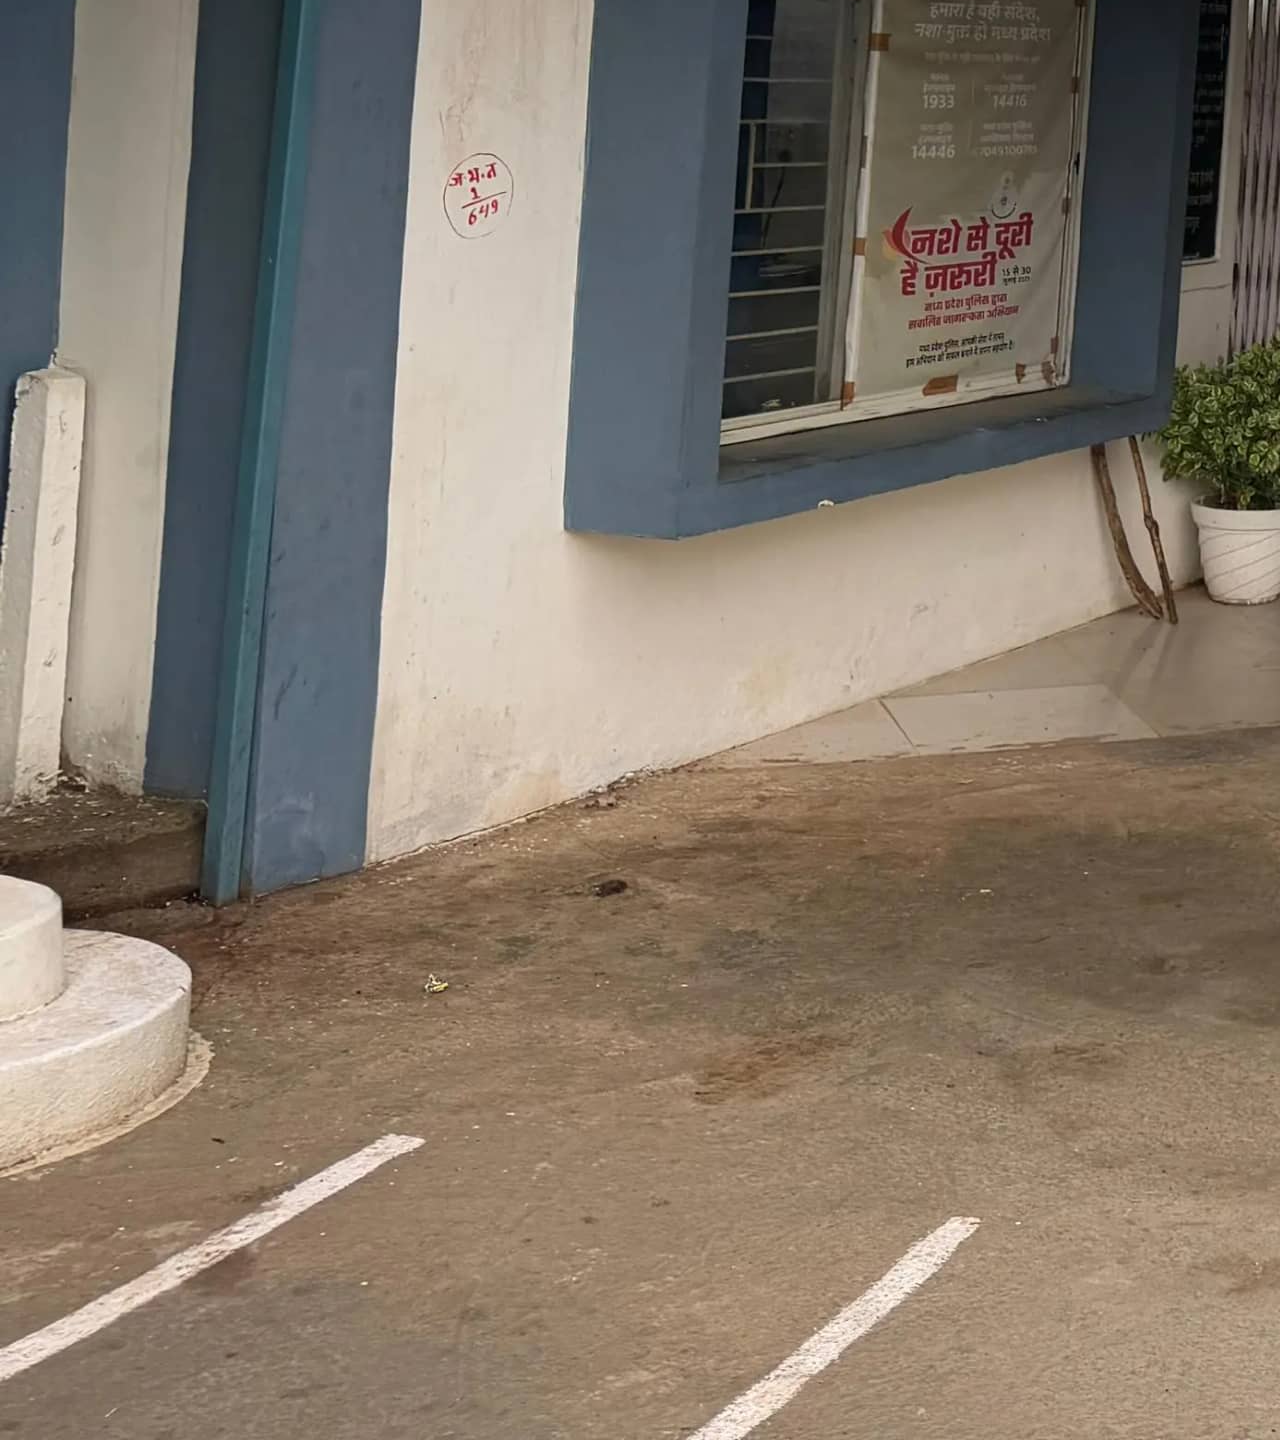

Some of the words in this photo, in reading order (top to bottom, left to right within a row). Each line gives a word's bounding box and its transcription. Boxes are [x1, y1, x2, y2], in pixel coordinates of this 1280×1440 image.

[923, 94, 956, 110] 1933
[912, 144, 956, 159] 14446
[911, 219, 962, 256] नशे
[967, 216, 990, 252] से
[995, 212, 1033, 260] दूरी
[900, 260, 918, 295] है
